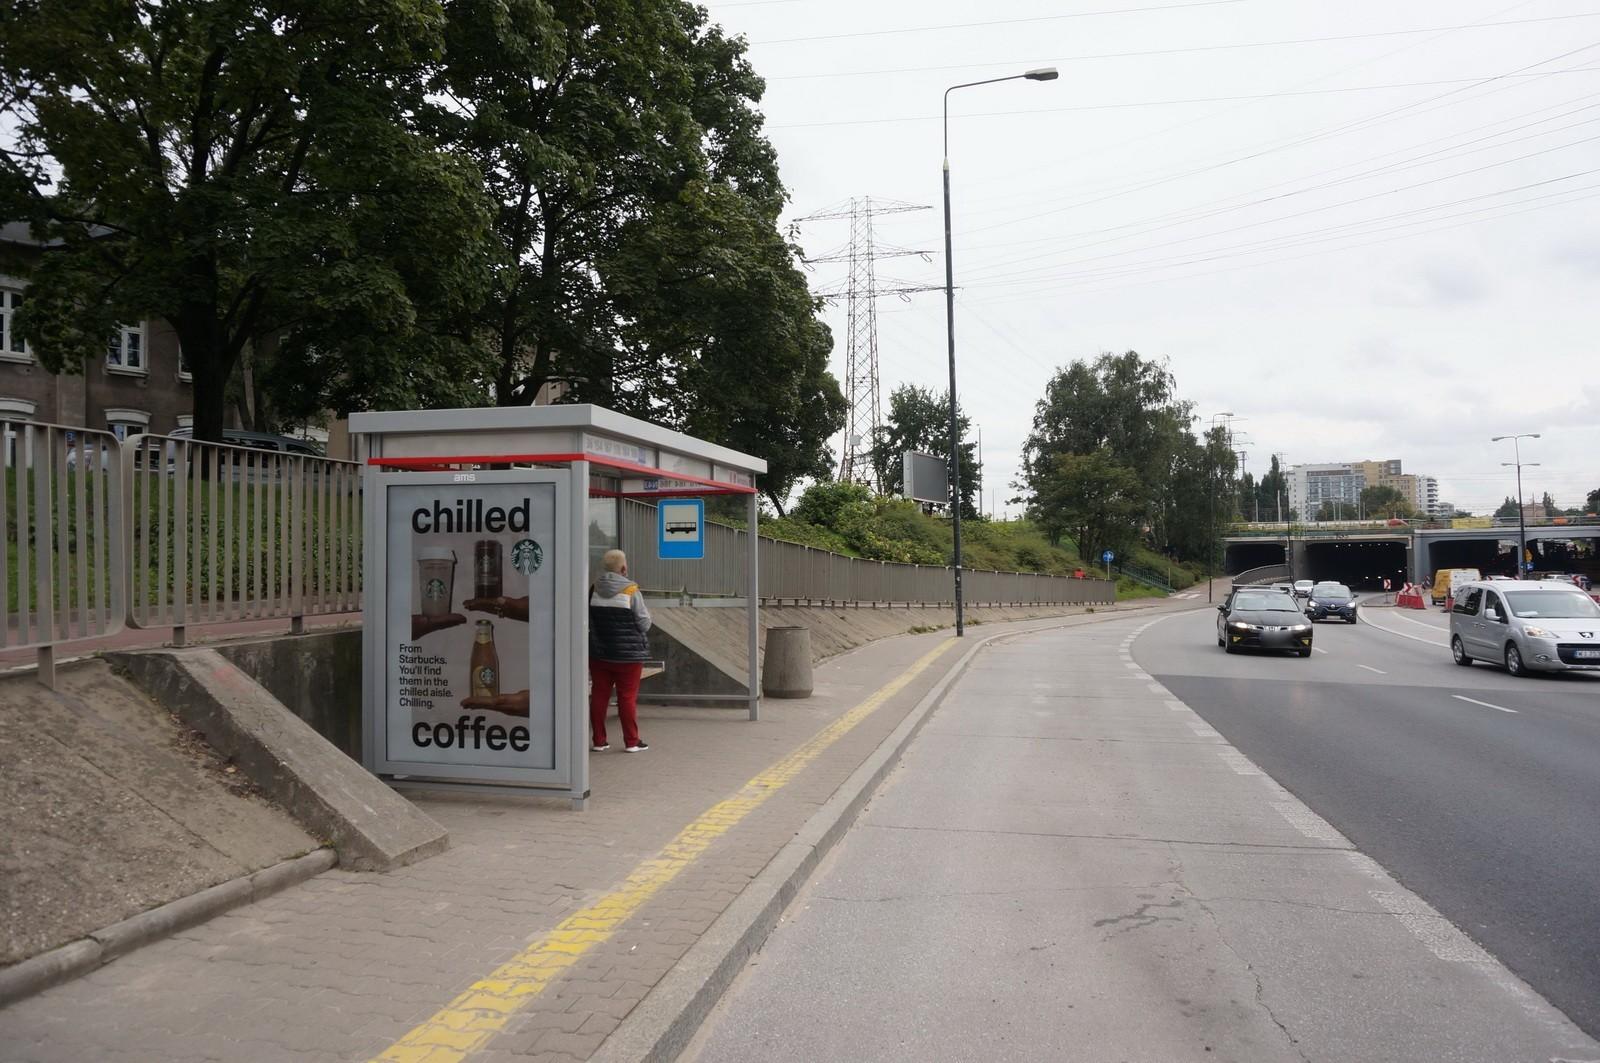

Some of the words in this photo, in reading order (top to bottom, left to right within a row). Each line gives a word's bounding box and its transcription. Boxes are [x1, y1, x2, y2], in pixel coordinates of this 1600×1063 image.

[454, 473, 475, 482] ams
[412, 498, 530, 534] chilled
[400, 643, 422, 653] From
[399, 654, 447, 665] Starbucks.
[424, 665, 442, 675] find
[399, 676, 422, 686] them
[424, 677, 432, 686] in
[434, 677, 449, 687] the
[400, 687, 429, 697] chilled
[430, 687, 453, 698] aisle.
[399, 697, 434, 710] Chilling.
[412, 715, 530, 752] coffee
